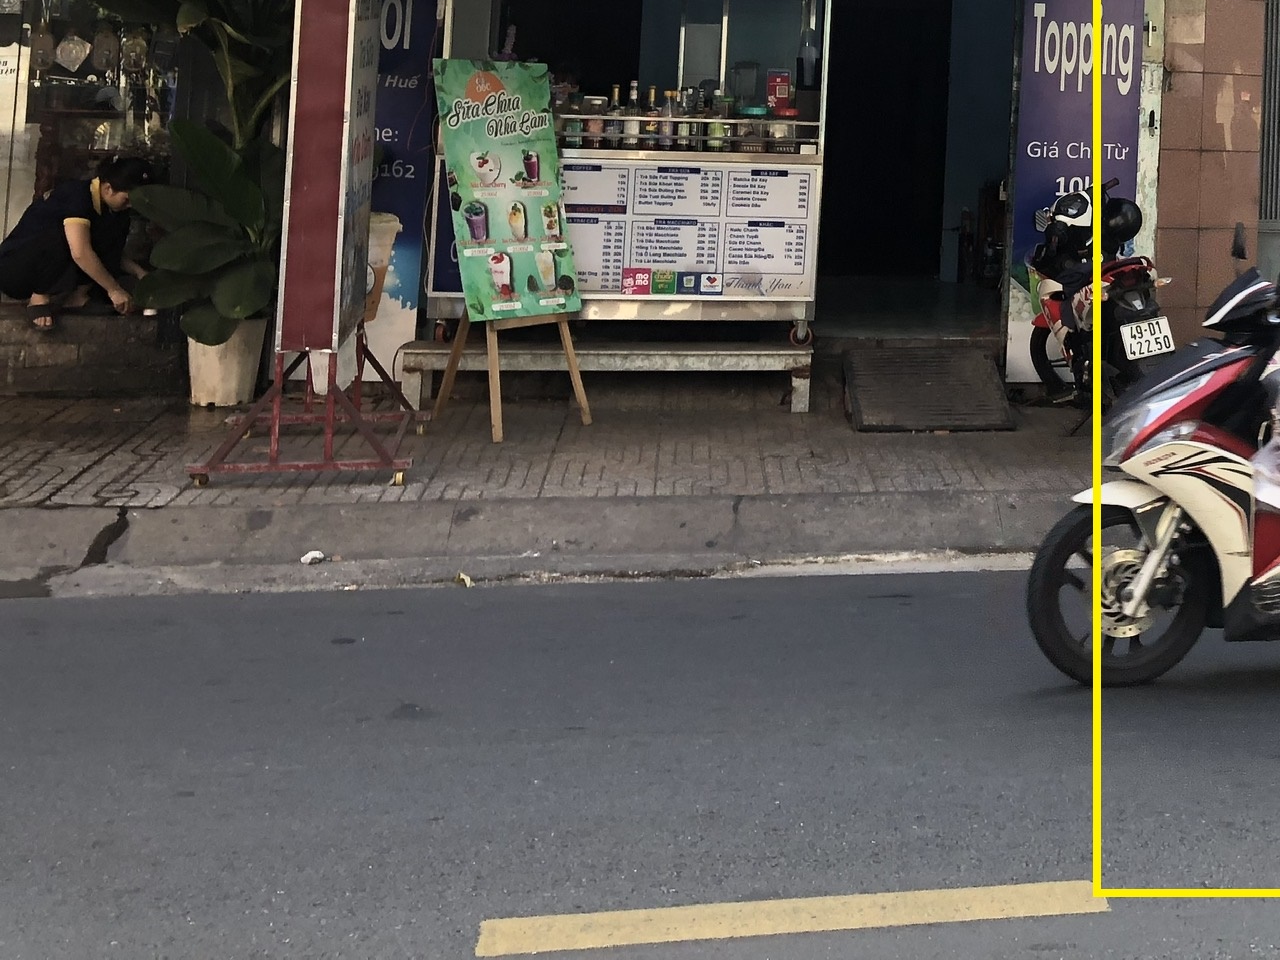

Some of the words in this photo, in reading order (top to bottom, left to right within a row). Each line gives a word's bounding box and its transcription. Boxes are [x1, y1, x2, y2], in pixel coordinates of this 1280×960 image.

[1033, 2, 1135, 96] Toppng
[1027, 141, 1060, 159] Giá
[1066, 142, 1092, 159] Ch
[1104, 141, 1129, 160] Từ
[1129, 320, 1163, 342] 49-D1
[1128, 334, 1172, 357] 422.50
